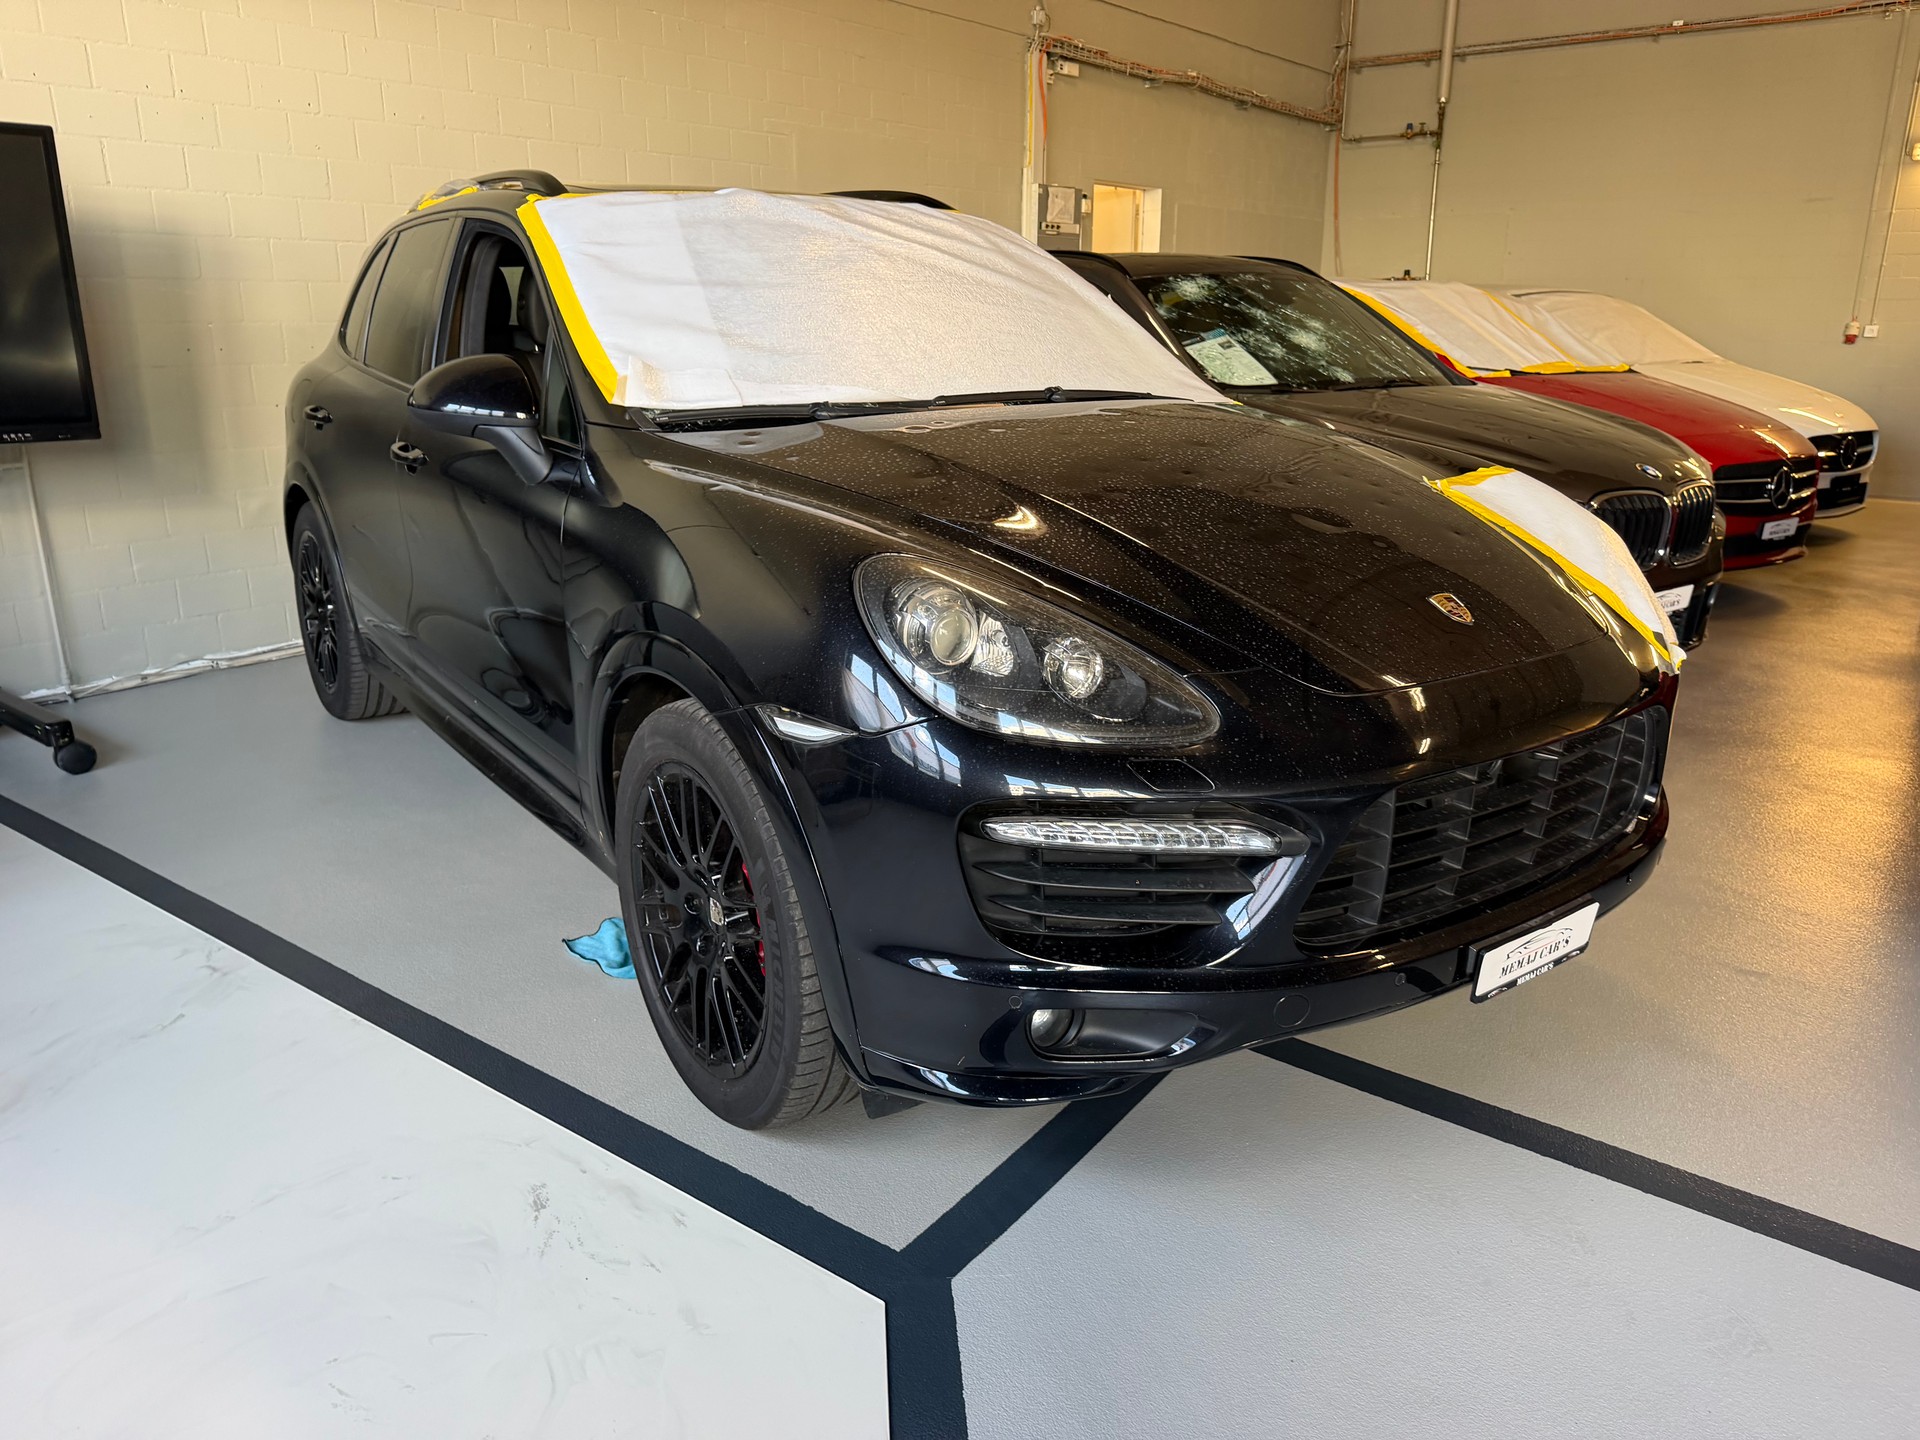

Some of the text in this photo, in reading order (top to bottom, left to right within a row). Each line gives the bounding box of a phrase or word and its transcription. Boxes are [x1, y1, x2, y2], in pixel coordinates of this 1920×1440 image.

[1499, 935, 1571, 978] MEMAJ CAR'S
[767, 918, 785, 1062] MICHELIN
[1517, 971, 1537, 986] MEMAJ
